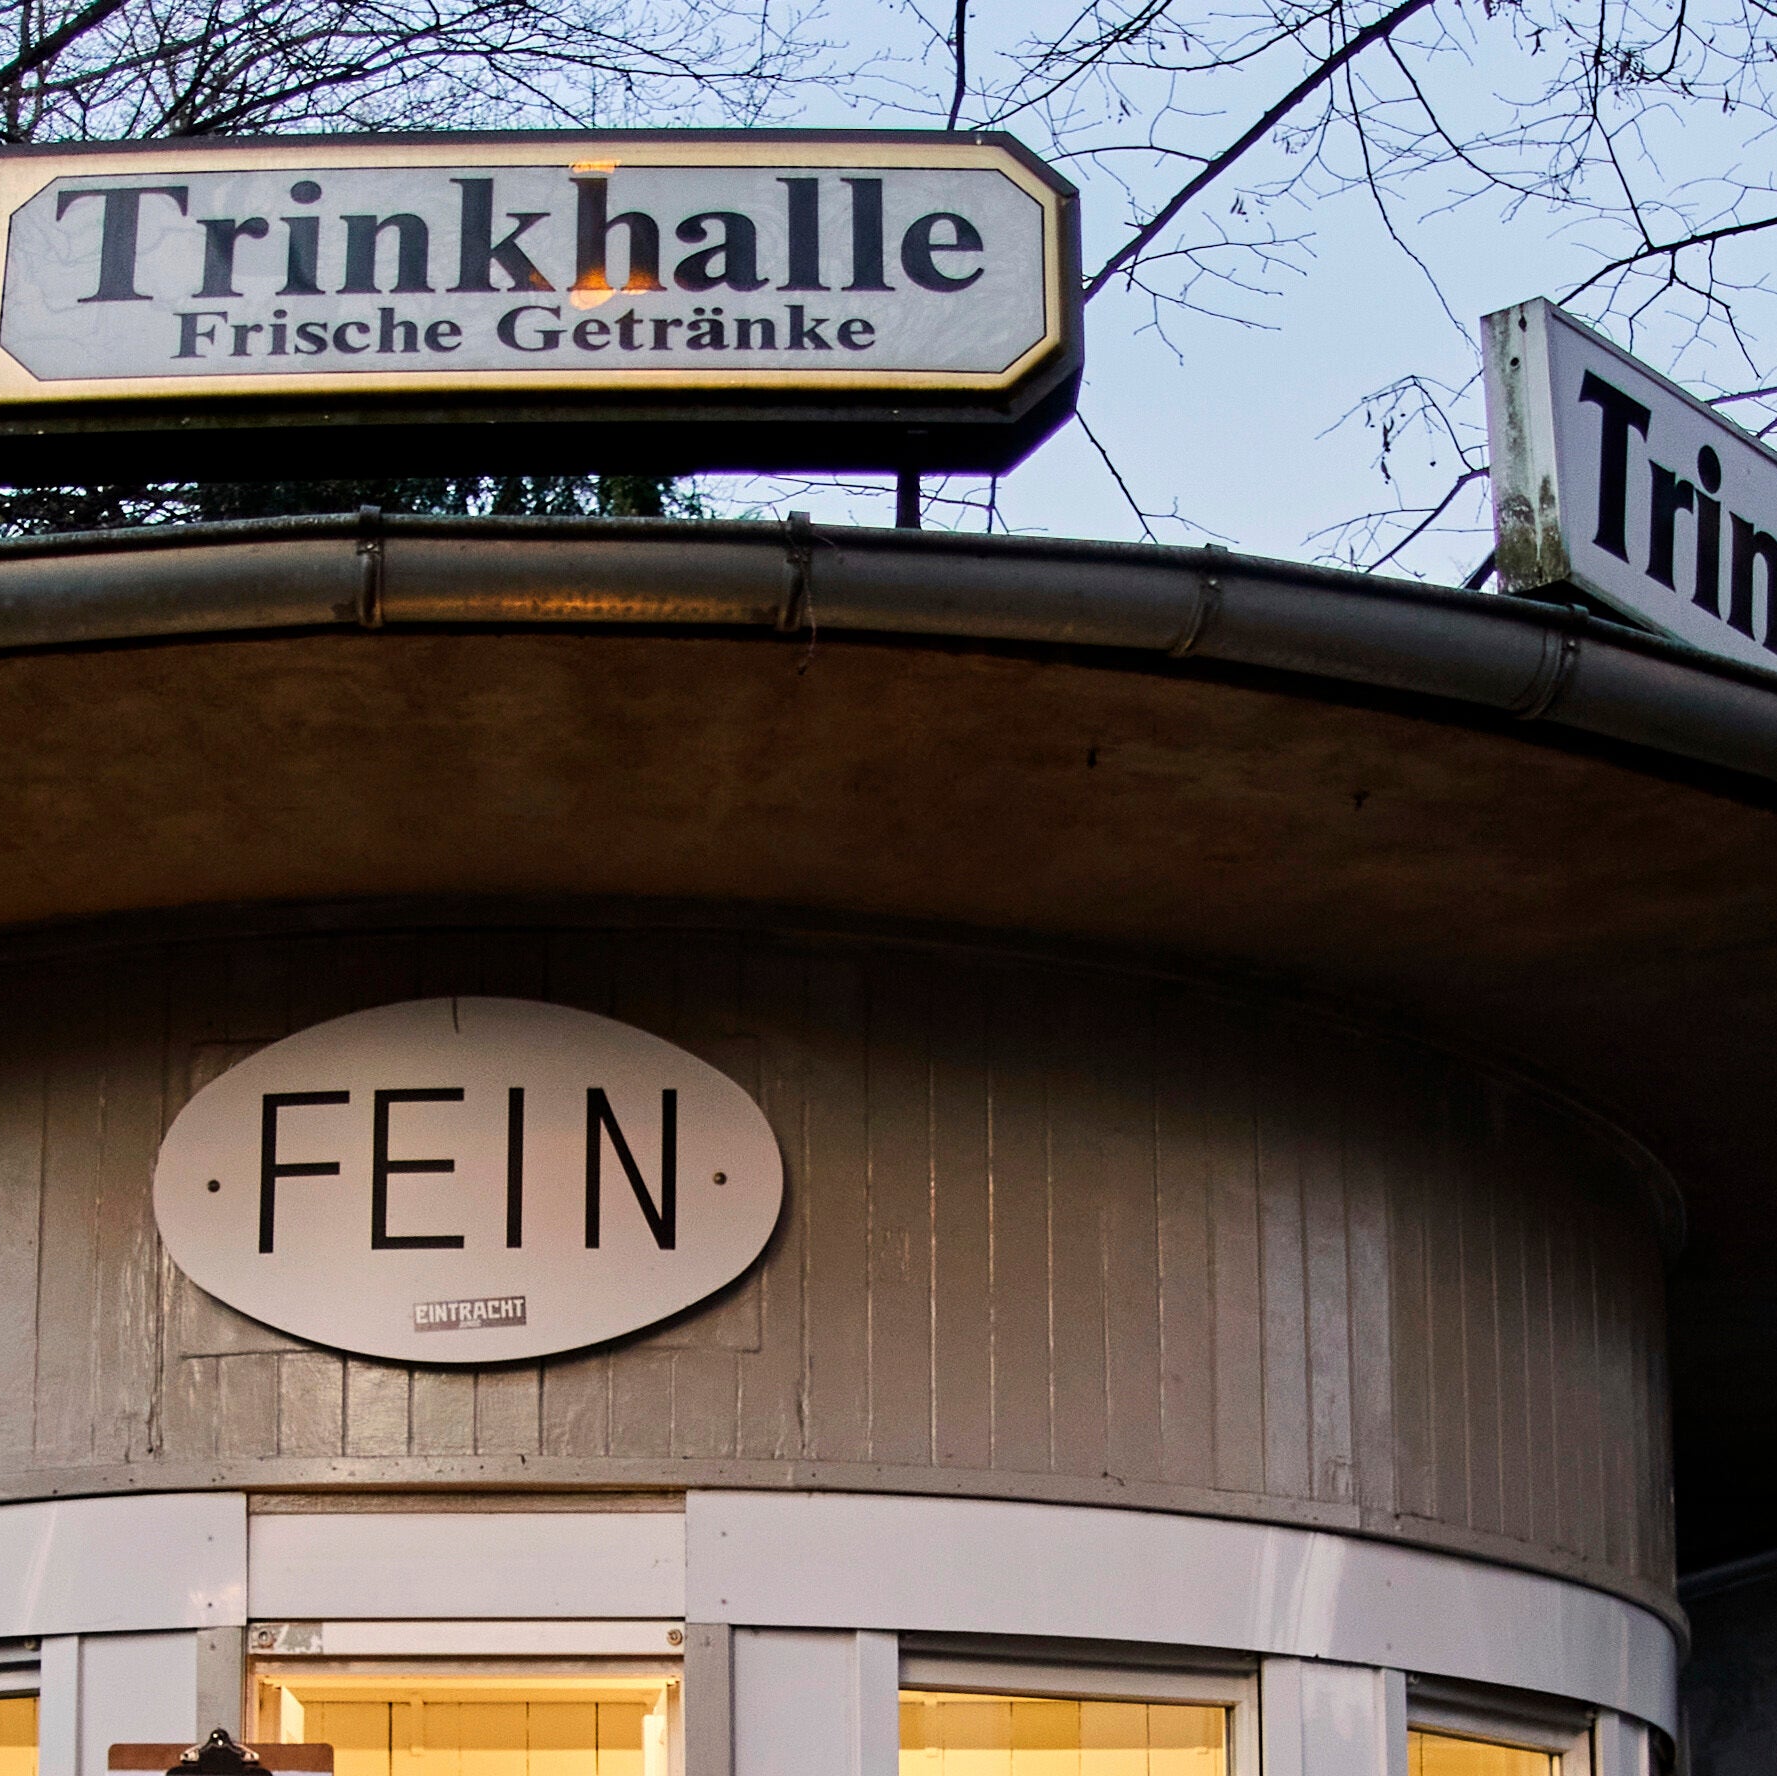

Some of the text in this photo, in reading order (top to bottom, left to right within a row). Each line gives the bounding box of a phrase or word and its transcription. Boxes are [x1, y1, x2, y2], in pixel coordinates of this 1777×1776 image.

[55, 177, 986, 305] Trinkhalle
[171, 303, 878, 360] Frische Getränke
[258, 1086, 678, 1254] FEIN
[415, 1299, 524, 1324] EINTRACHT
